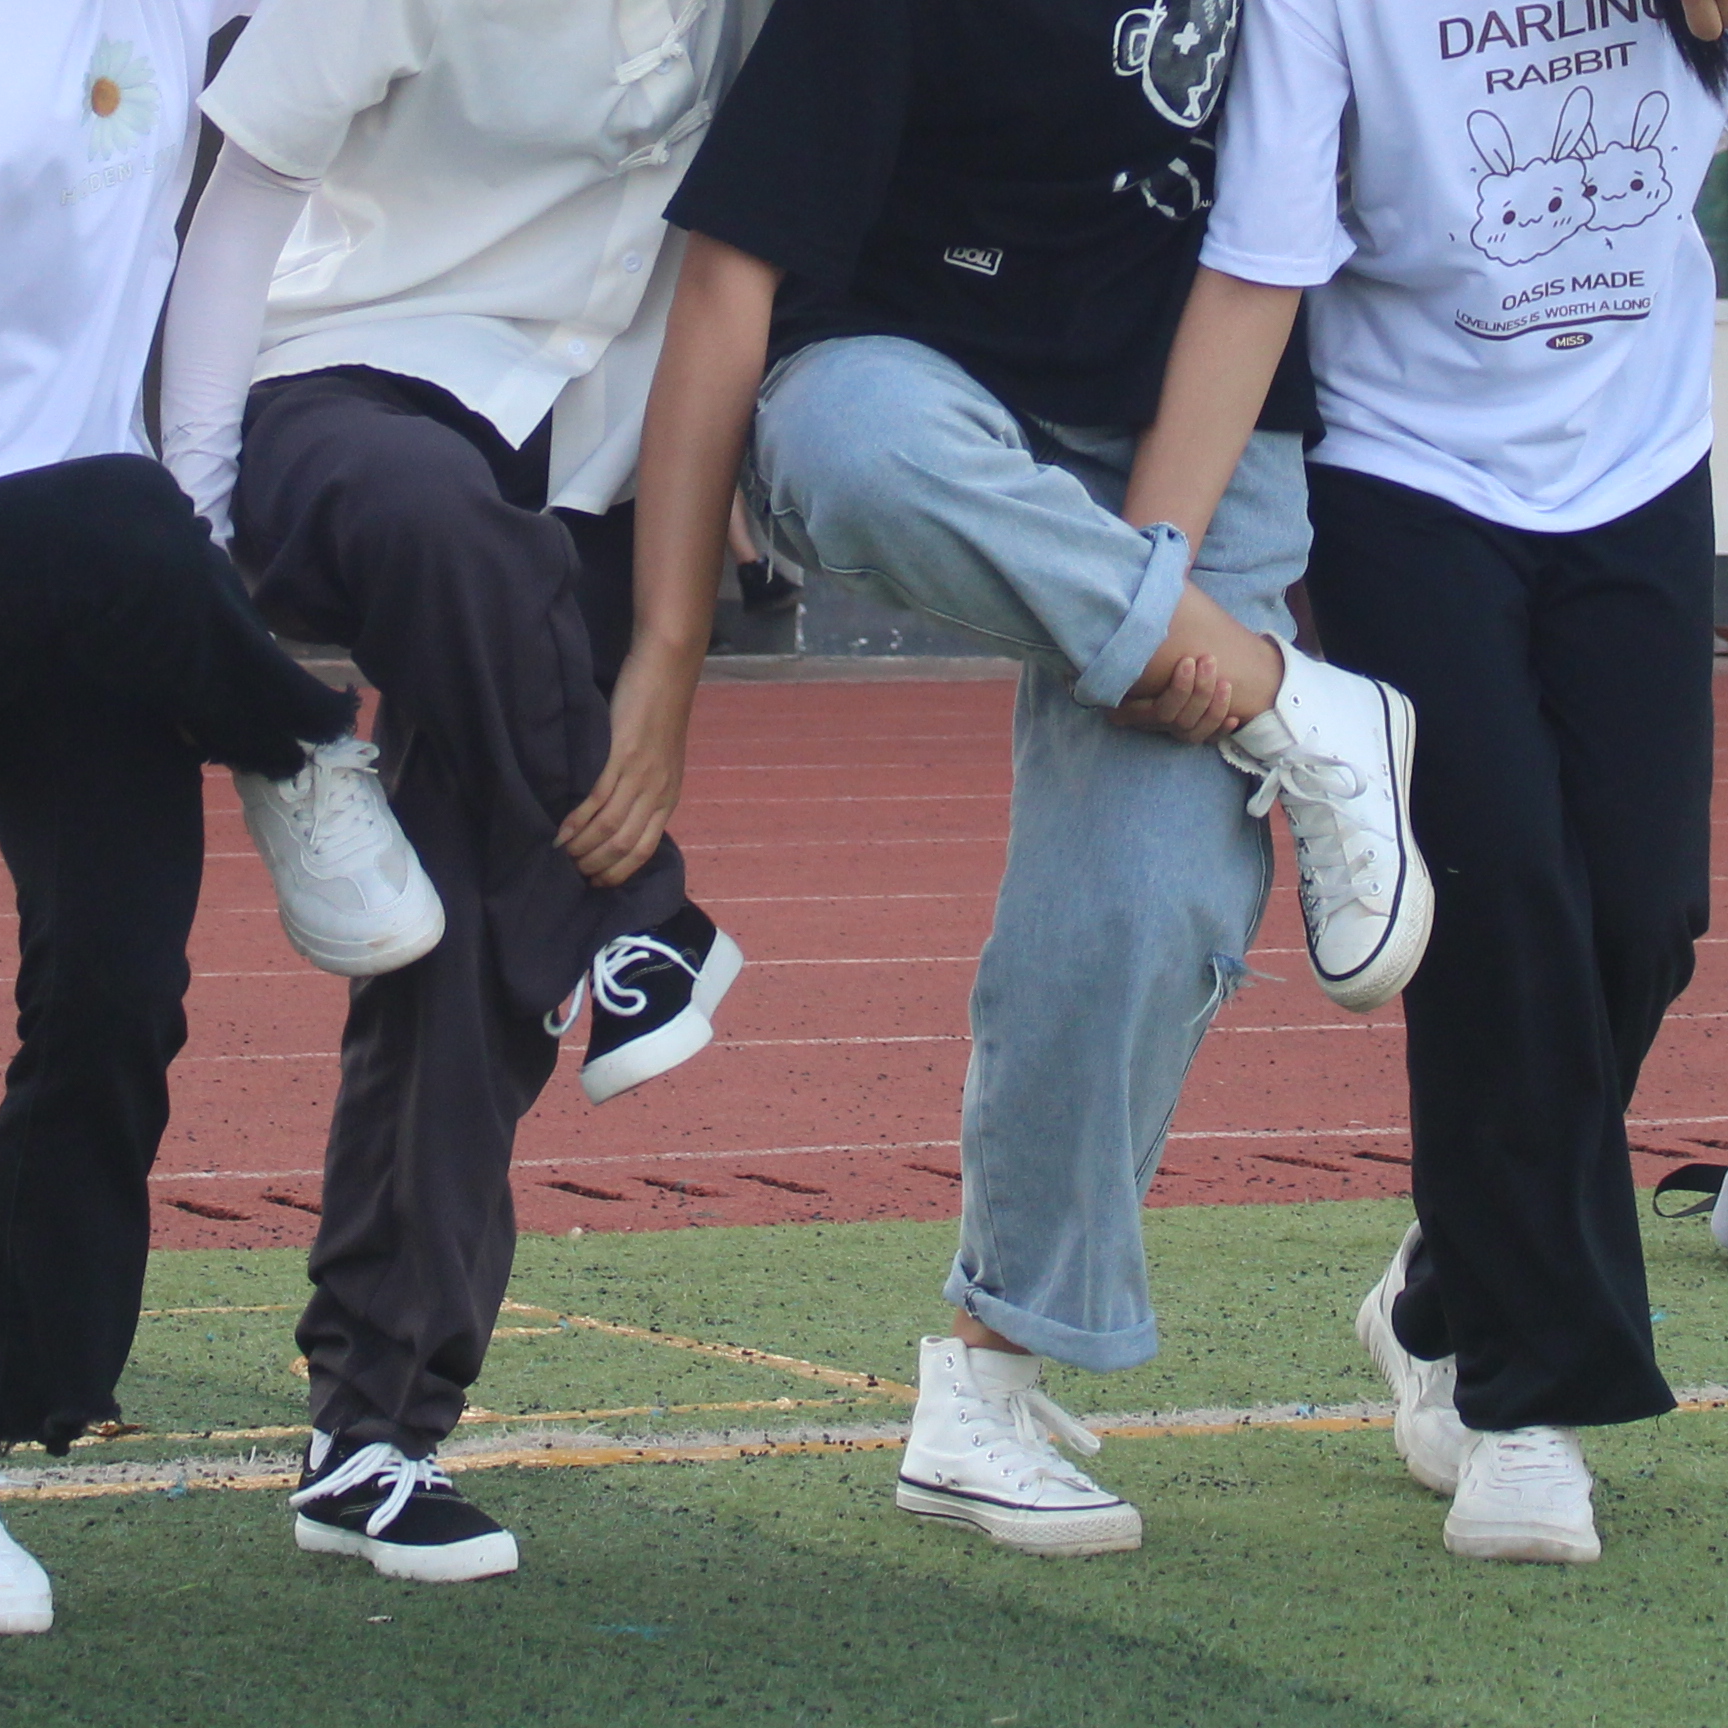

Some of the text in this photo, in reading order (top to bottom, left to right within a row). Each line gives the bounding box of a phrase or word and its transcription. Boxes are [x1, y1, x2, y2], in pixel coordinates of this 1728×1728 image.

[1485, 41, 1637, 95] RABBIT
[1502, 270, 1645, 312] OASIS MADE
[1455, 296, 1651, 333] LOVELINESS IS WORTH A LONG
[1555, 335, 1586, 348] MISS
